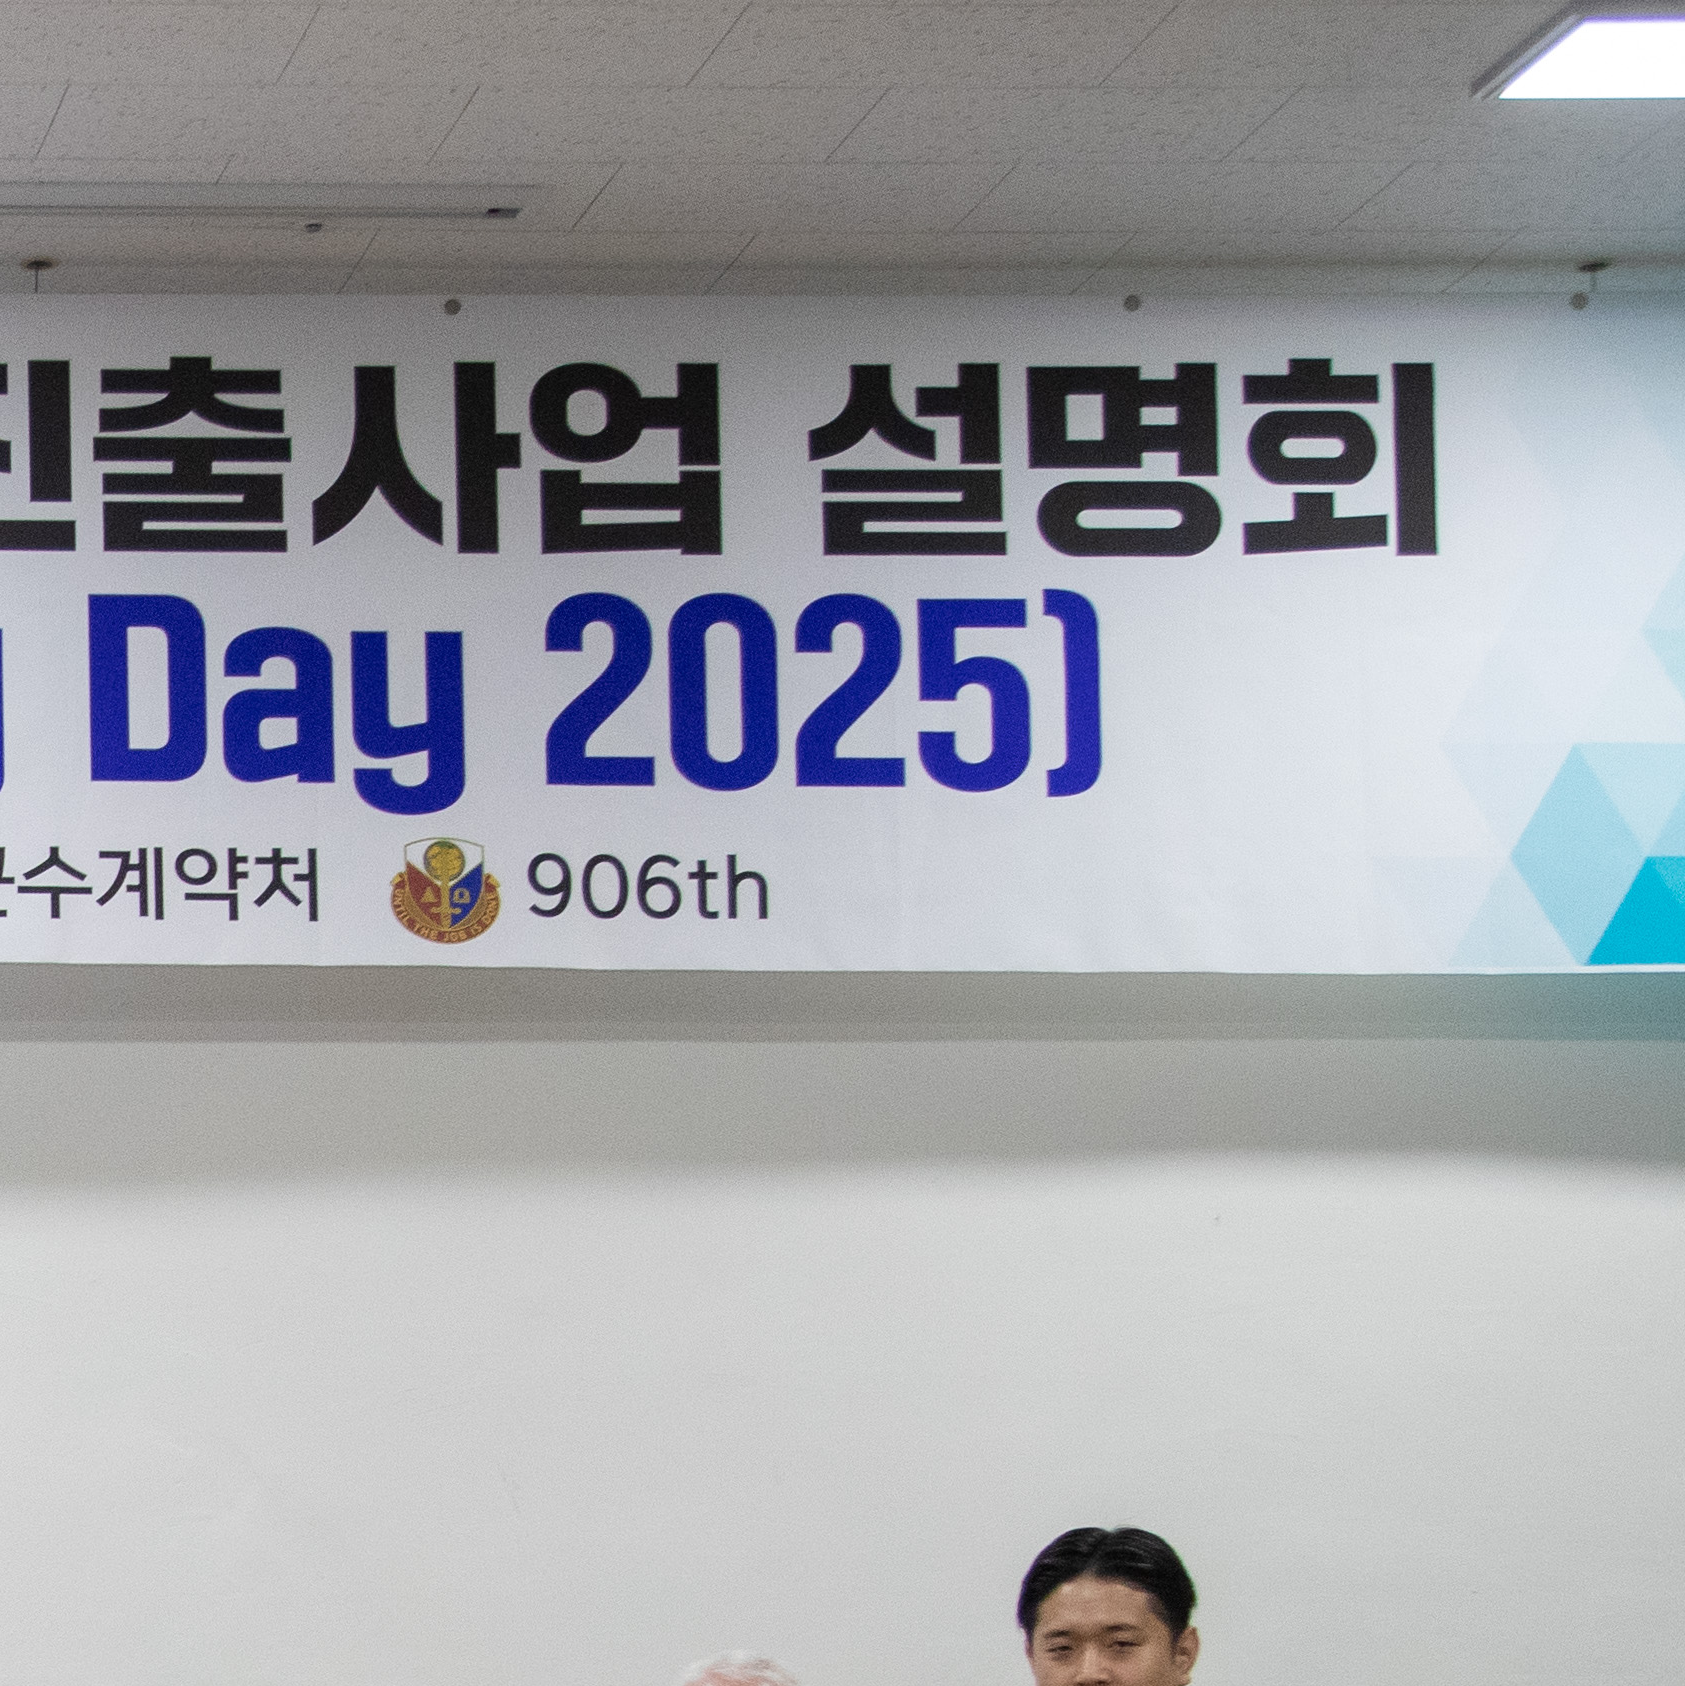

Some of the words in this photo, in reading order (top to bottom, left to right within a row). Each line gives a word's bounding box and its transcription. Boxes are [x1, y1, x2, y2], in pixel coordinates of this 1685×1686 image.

[807, 357, 1438, 557] 설명회
[87, 593, 466, 816] Day
[544, 588, 1103, 798] 2025)
[413, 922, 438, 940] THE
[443, 930, 468, 942] JOB
[527, 852, 769, 920] 906th
